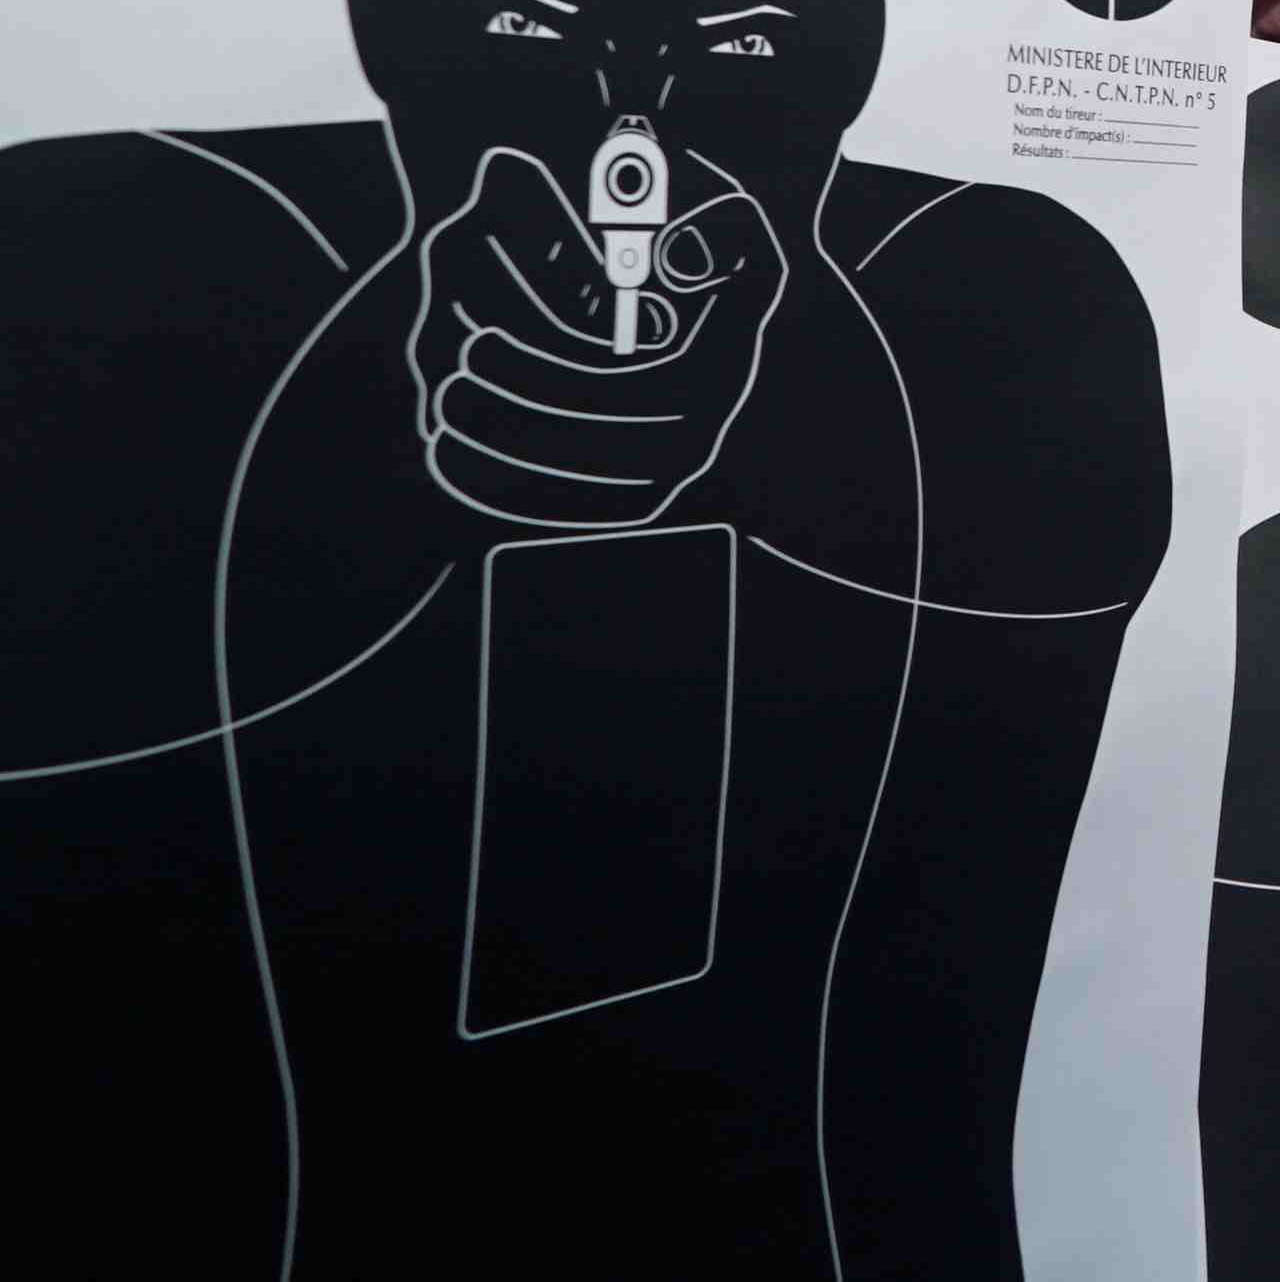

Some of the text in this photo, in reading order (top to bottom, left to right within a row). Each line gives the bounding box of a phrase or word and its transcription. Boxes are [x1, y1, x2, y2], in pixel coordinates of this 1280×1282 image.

[1007, 44, 1103, 71] MINISTERE
[1109, 53, 1129, 74] DE
[1014, 104, 1043, 118] Nom
[1046, 105, 1062, 119] du
[1013, 123, 1062, 139] Nombre
